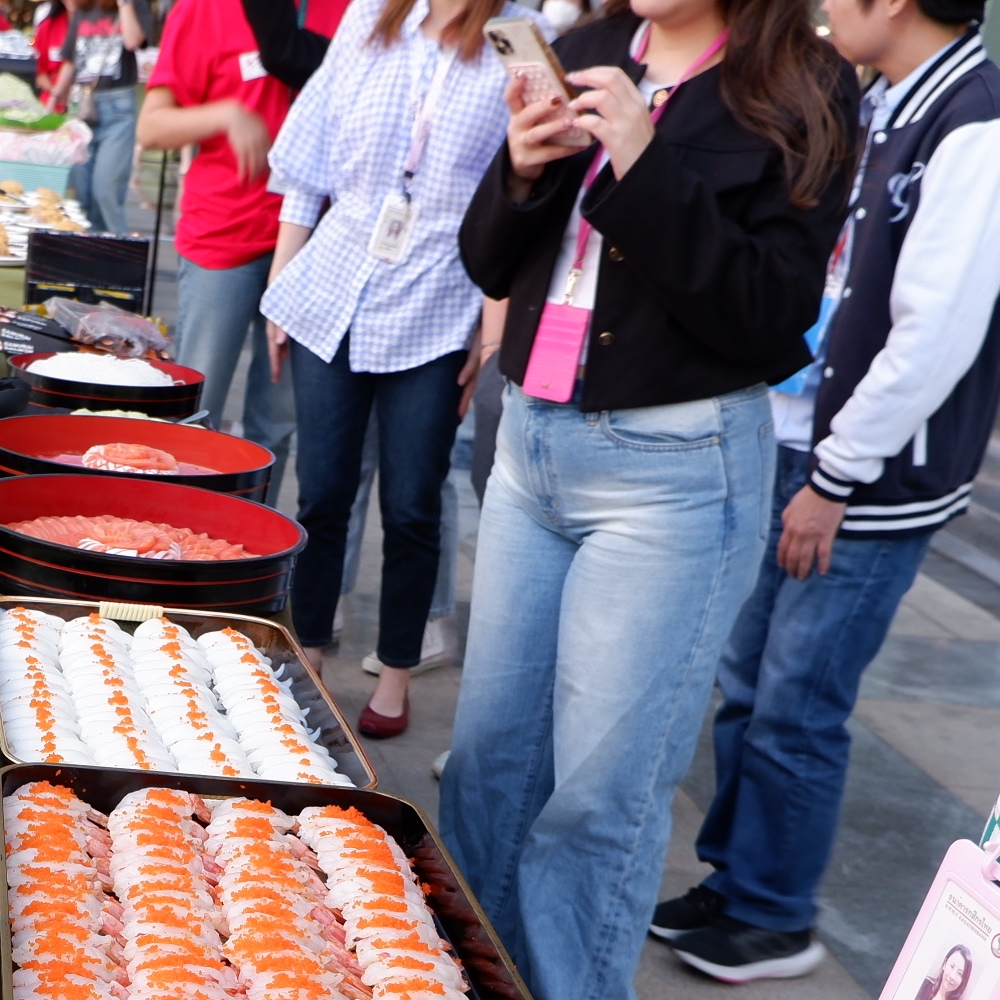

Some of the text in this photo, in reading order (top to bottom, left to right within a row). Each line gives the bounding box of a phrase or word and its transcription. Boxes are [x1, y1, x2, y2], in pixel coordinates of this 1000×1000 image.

[948, 894, 992, 934] ธนาคารกสิกรไทย
